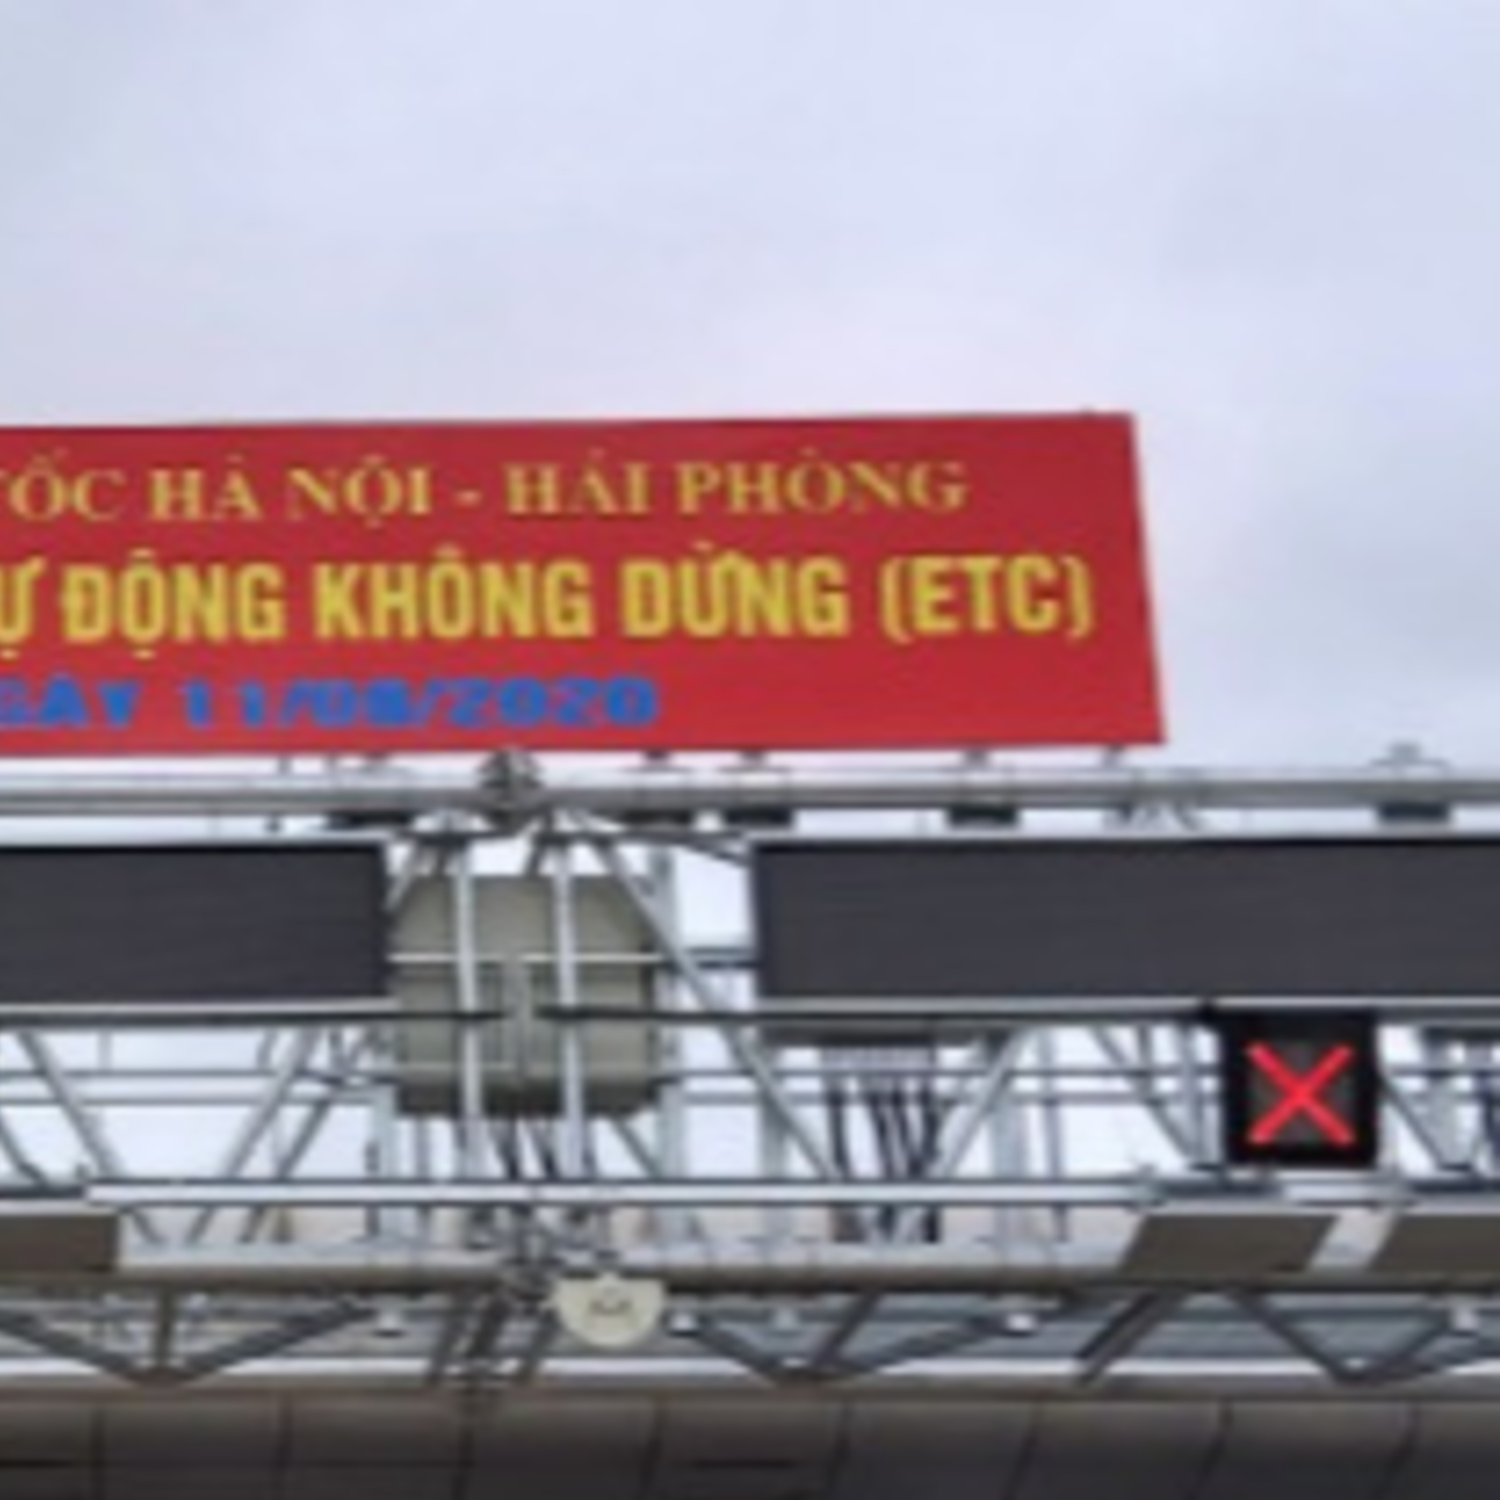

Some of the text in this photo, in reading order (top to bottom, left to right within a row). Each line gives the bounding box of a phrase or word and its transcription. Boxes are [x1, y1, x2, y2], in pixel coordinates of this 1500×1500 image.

[150, 455, 266, 521] HÀ
[286, 455, 432, 529] NỘI
[675, 449, 968, 517] PHÒNG
[59, 549, 285, 660] ĐỘNG
[314, 545, 595, 640] KHÔNG
[620, 540, 850, 637] DỪNG
[879, 553, 1093, 643] (ETC)
